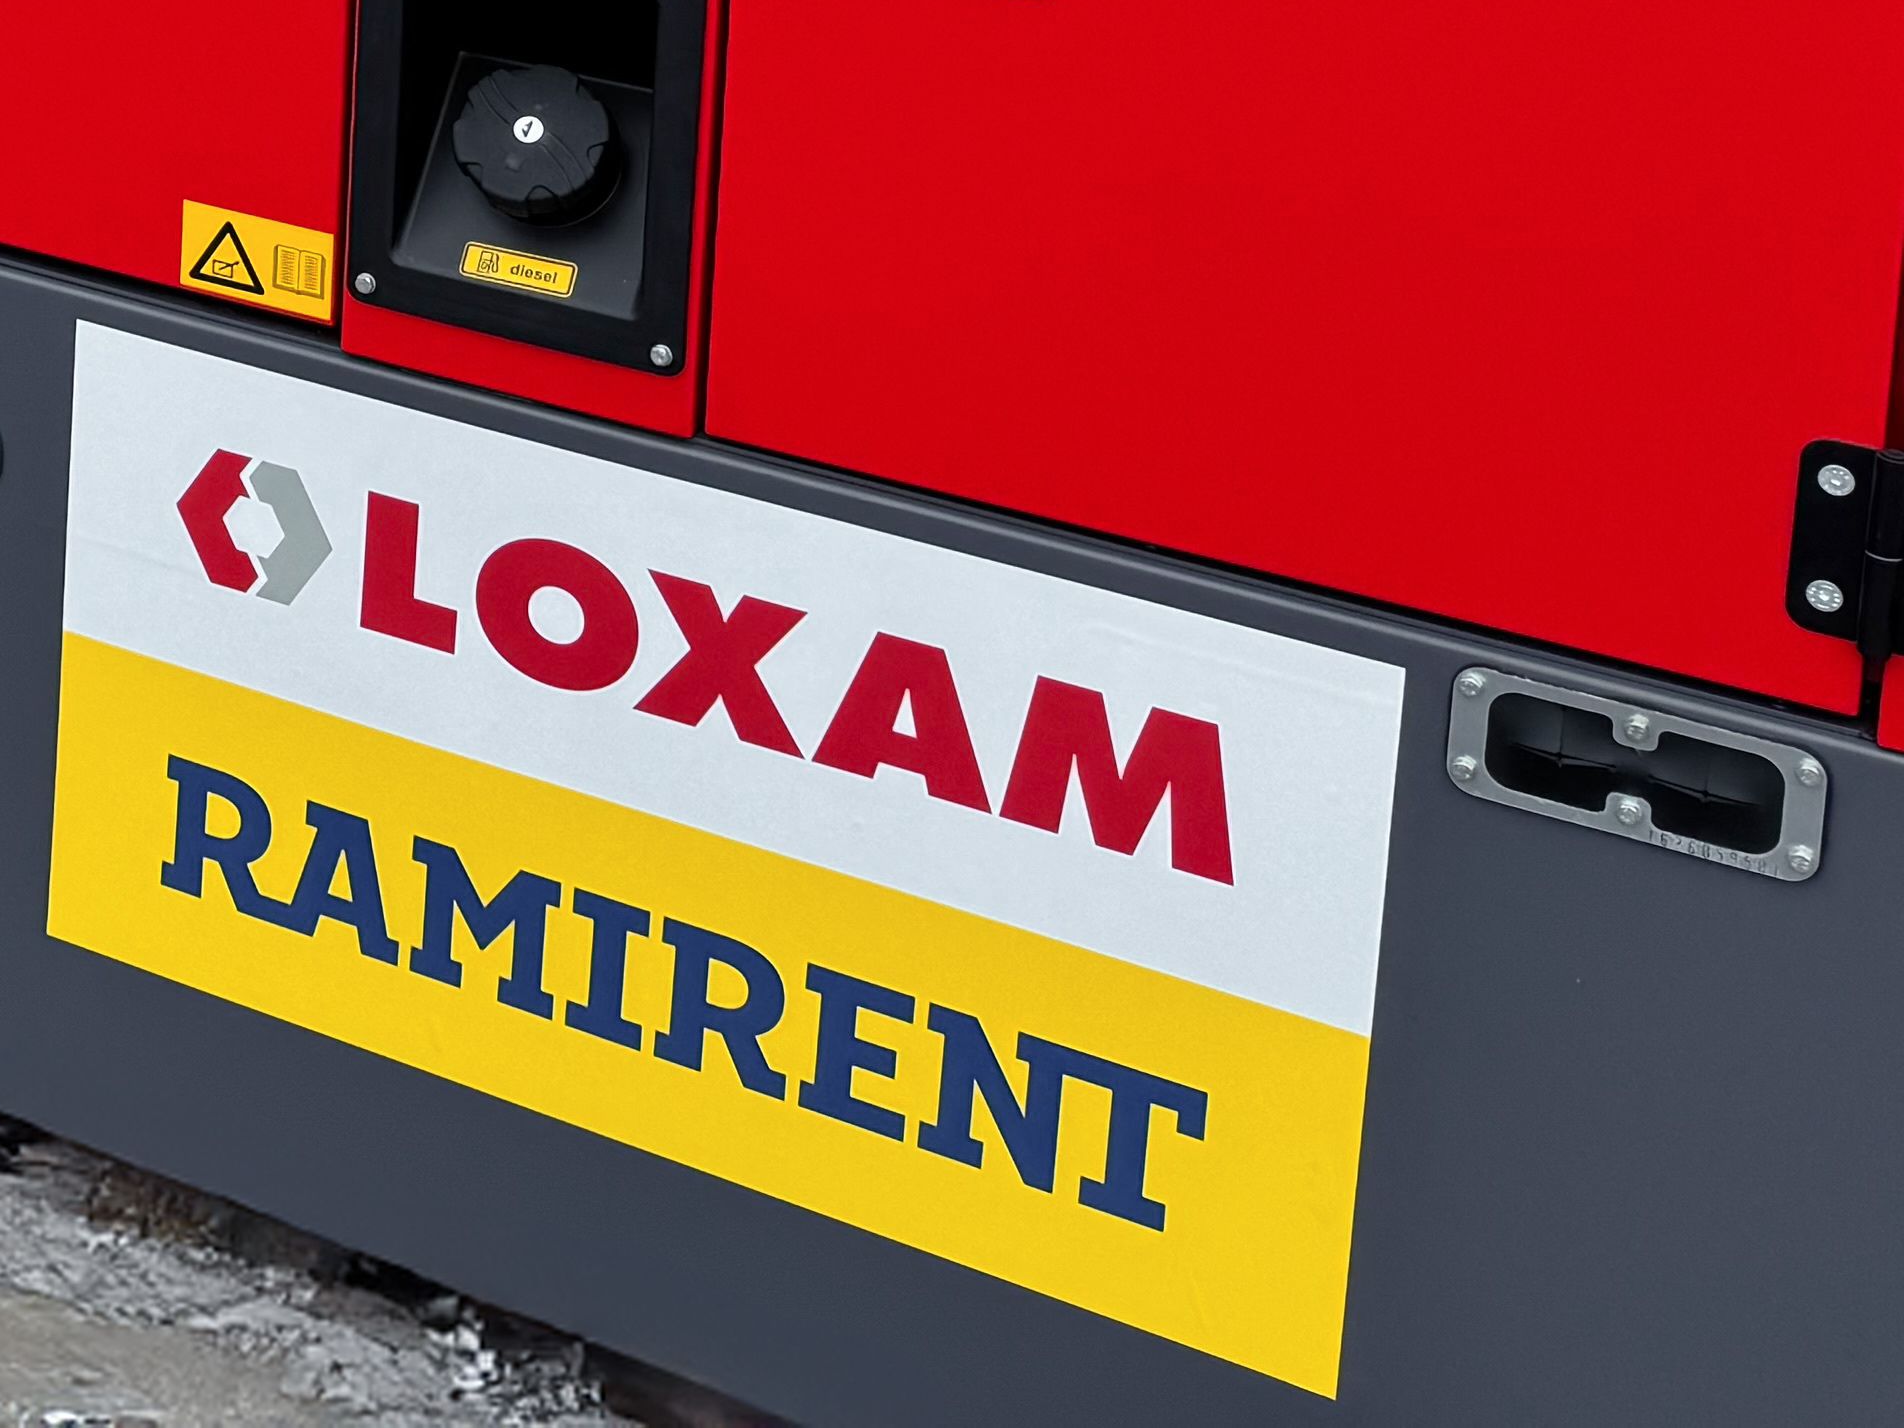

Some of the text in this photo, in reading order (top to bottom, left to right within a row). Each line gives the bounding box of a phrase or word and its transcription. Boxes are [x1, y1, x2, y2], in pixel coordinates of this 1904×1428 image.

[510, 264, 558, 284] diesel
[358, 491, 1234, 887] LOXAM
[158, 750, 1208, 1233] RAMIRENT
